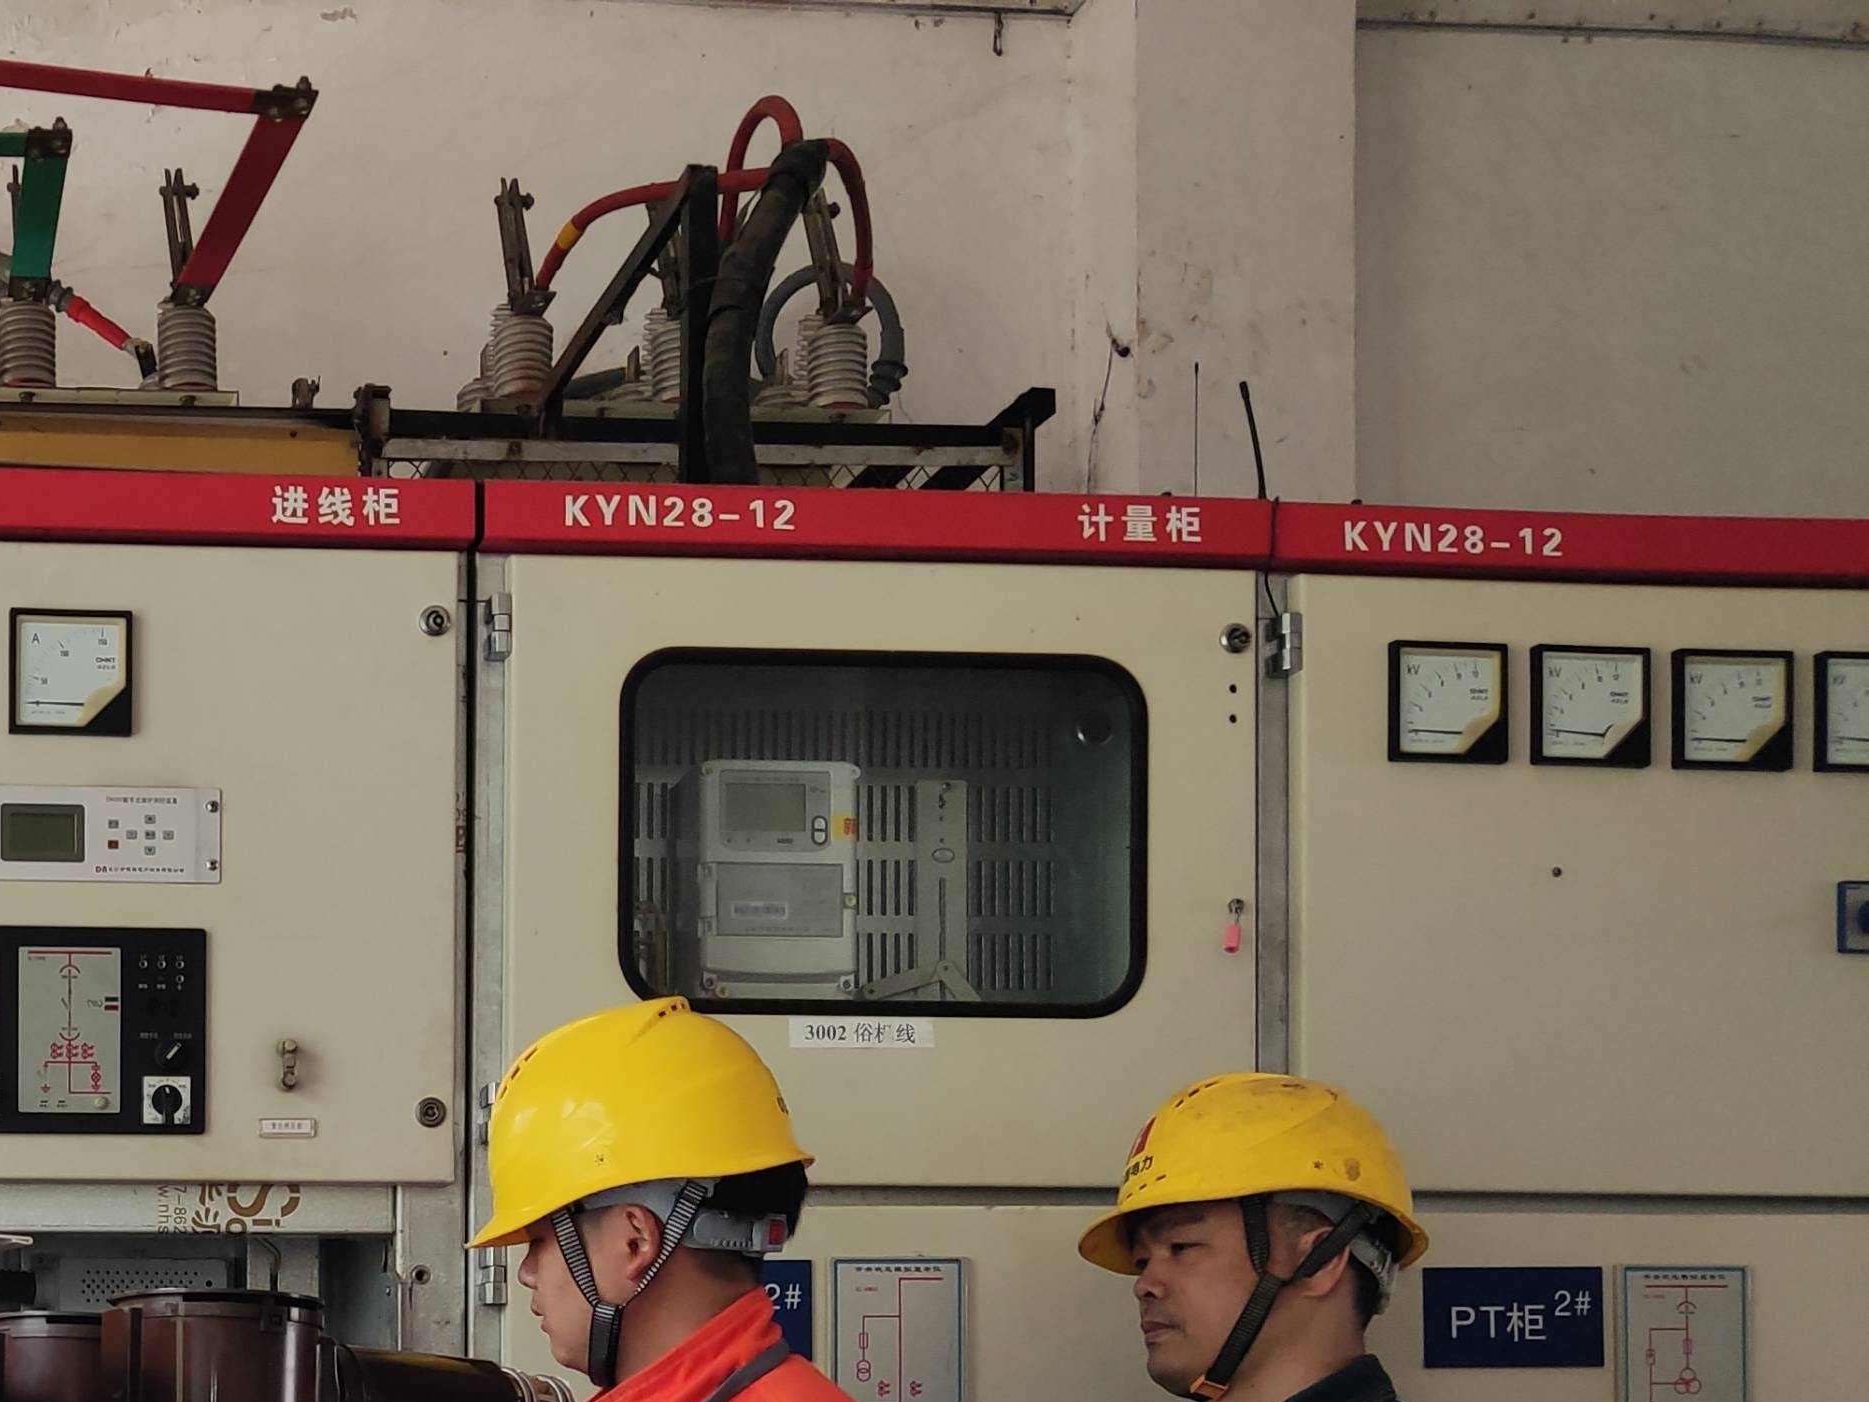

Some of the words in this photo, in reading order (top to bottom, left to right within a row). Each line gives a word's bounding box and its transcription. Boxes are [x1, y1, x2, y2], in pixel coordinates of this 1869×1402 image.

[271, 485, 401, 526] 进线柜
[564, 494, 795, 530] KYN28-12
[1077, 503, 1202, 542] 计量柜
[1344, 520, 1563, 557] KYN28-12
[804, 1024, 847, 1041] 3002
[1451, 1302, 1547, 1342] PT柜
[1554, 1290, 1591, 1317] 2#
